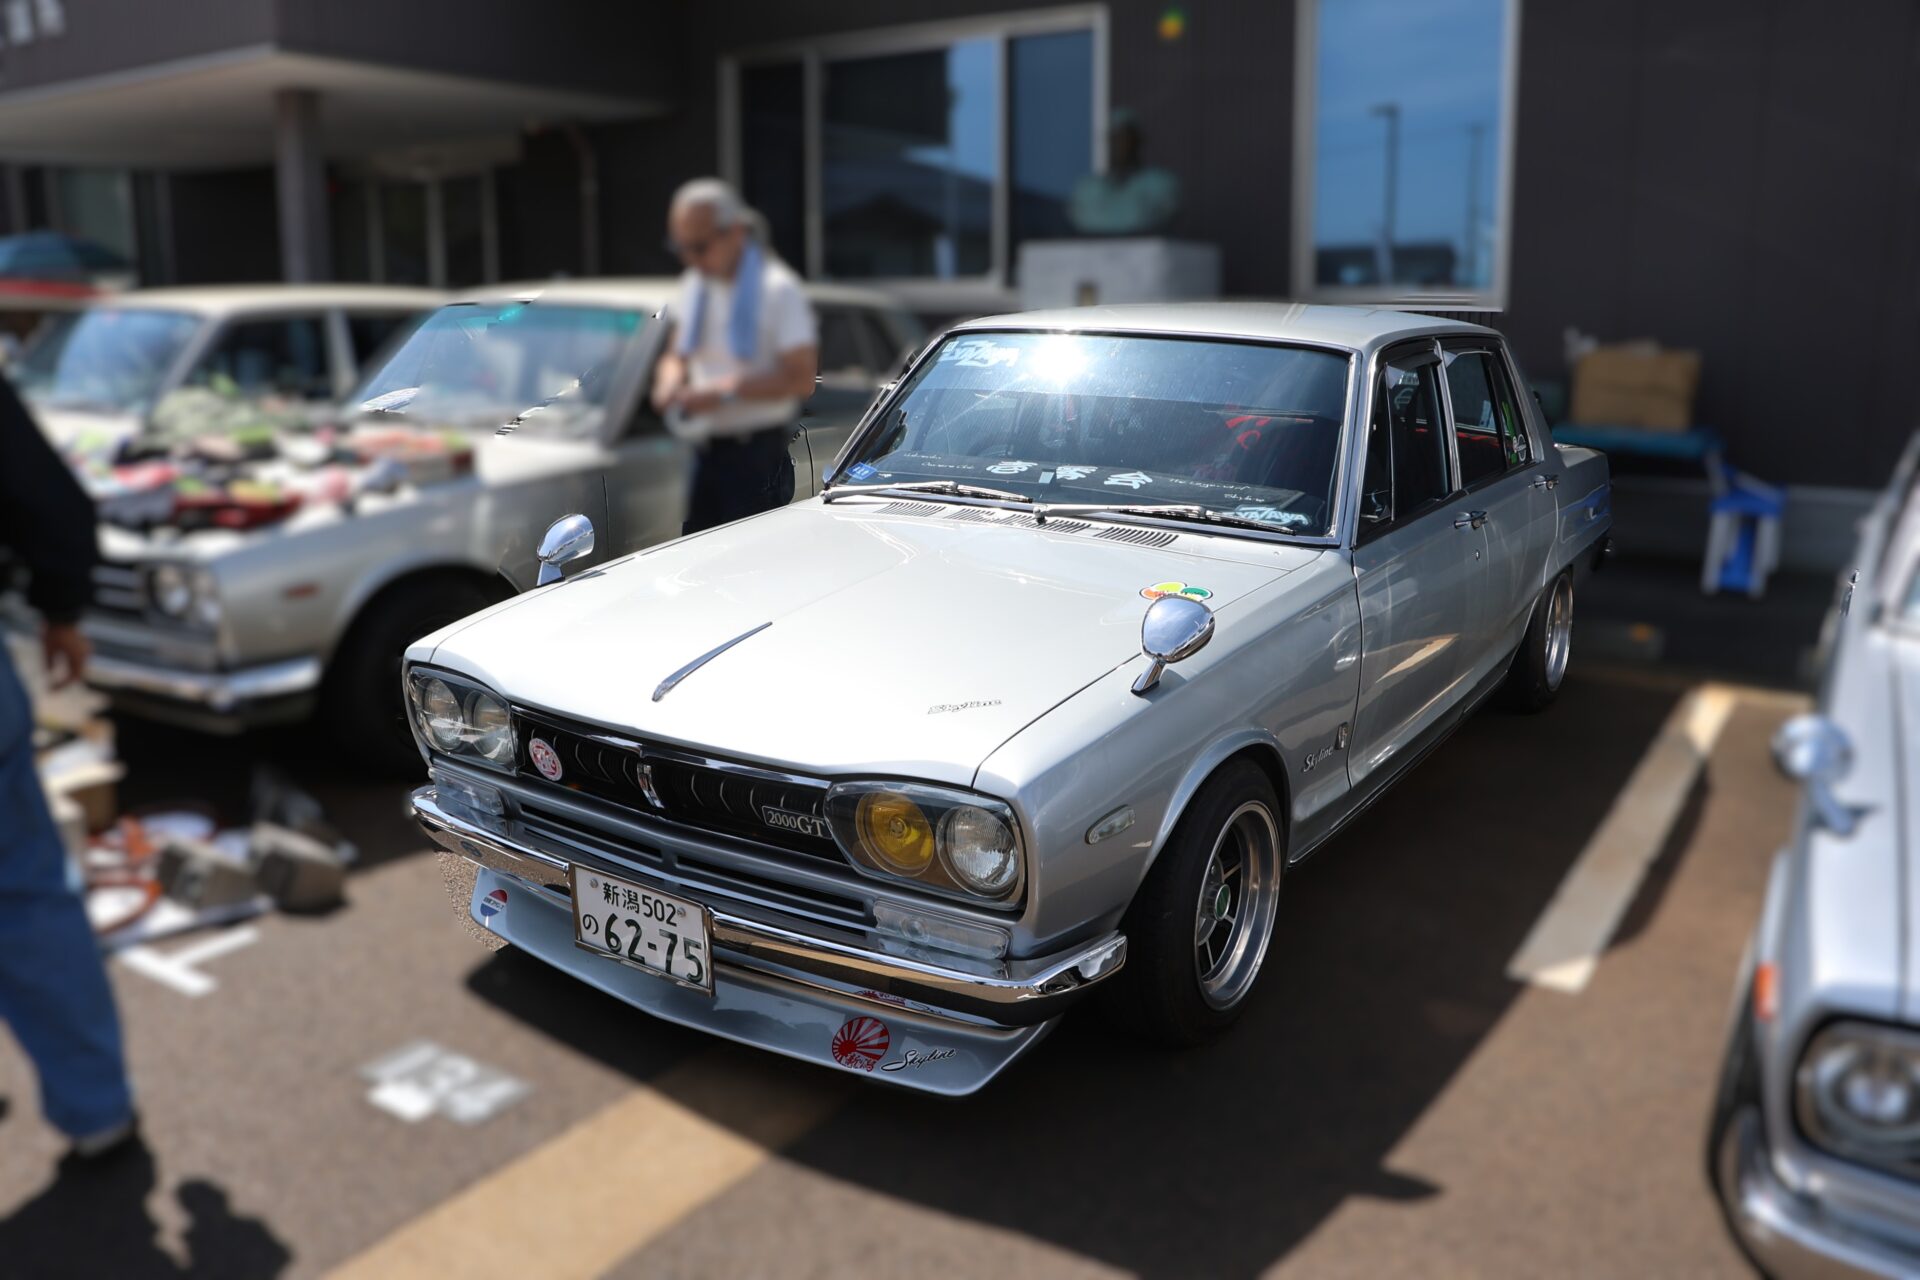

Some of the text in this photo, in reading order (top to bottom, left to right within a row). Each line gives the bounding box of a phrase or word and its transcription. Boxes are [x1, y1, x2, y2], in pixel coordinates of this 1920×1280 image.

[767, 810, 826, 838] 2000GT
[582, 912, 704, 984] の 62-75
[881, 1049, 957, 1072] Skyline
